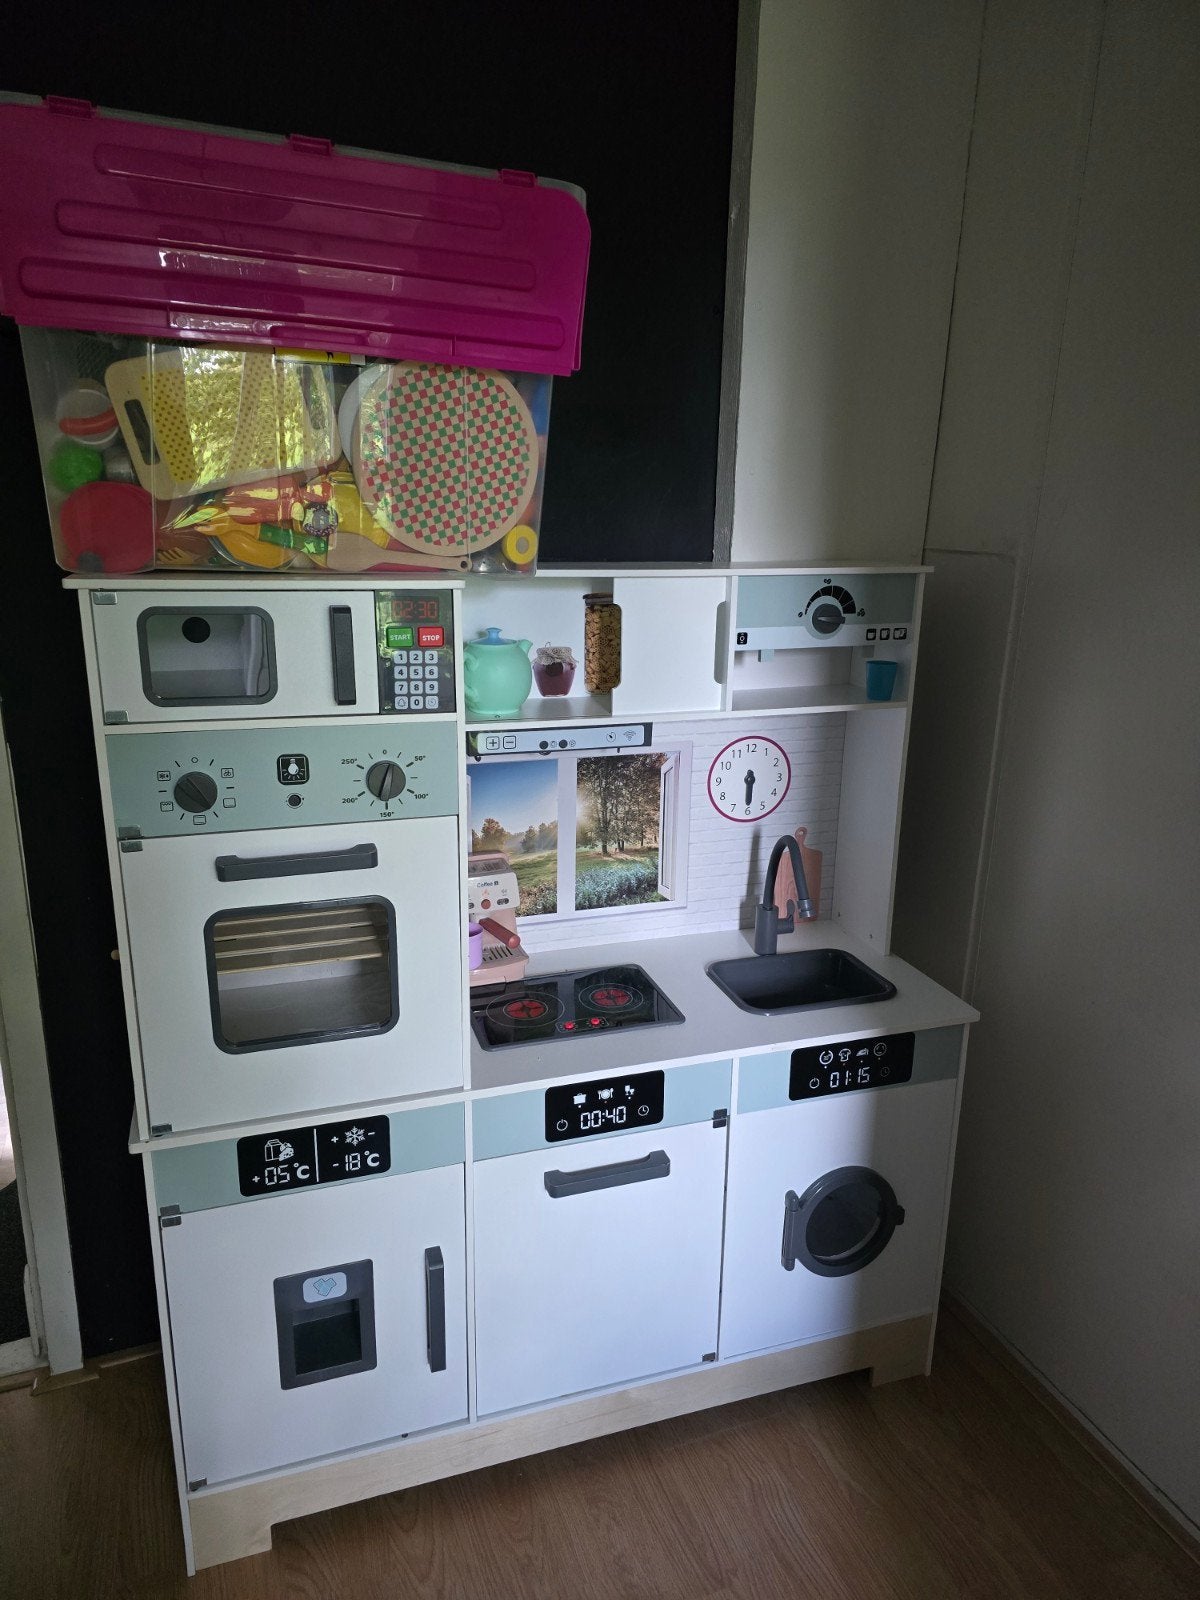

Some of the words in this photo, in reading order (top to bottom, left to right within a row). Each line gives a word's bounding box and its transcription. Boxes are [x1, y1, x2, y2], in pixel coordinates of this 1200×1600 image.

[389, 633, 411, 641] START
[746, 743, 757, 753] 12
[732, 749, 742, 758] 11
[721, 761, 732, 770] 10
[774, 758, 779, 767] 2
[716, 776, 722, 786] 9
[776, 772, 782, 782] 3
[720, 792, 726, 800] 8
[770, 788, 778, 796] 4
[730, 804, 736, 812] 7
[760, 801, 766, 810] 5
[745, 807, 751, 815] 6
[829, 1066, 871, 1089] 01:15
[580, 1105, 627, 1130] 00:40
